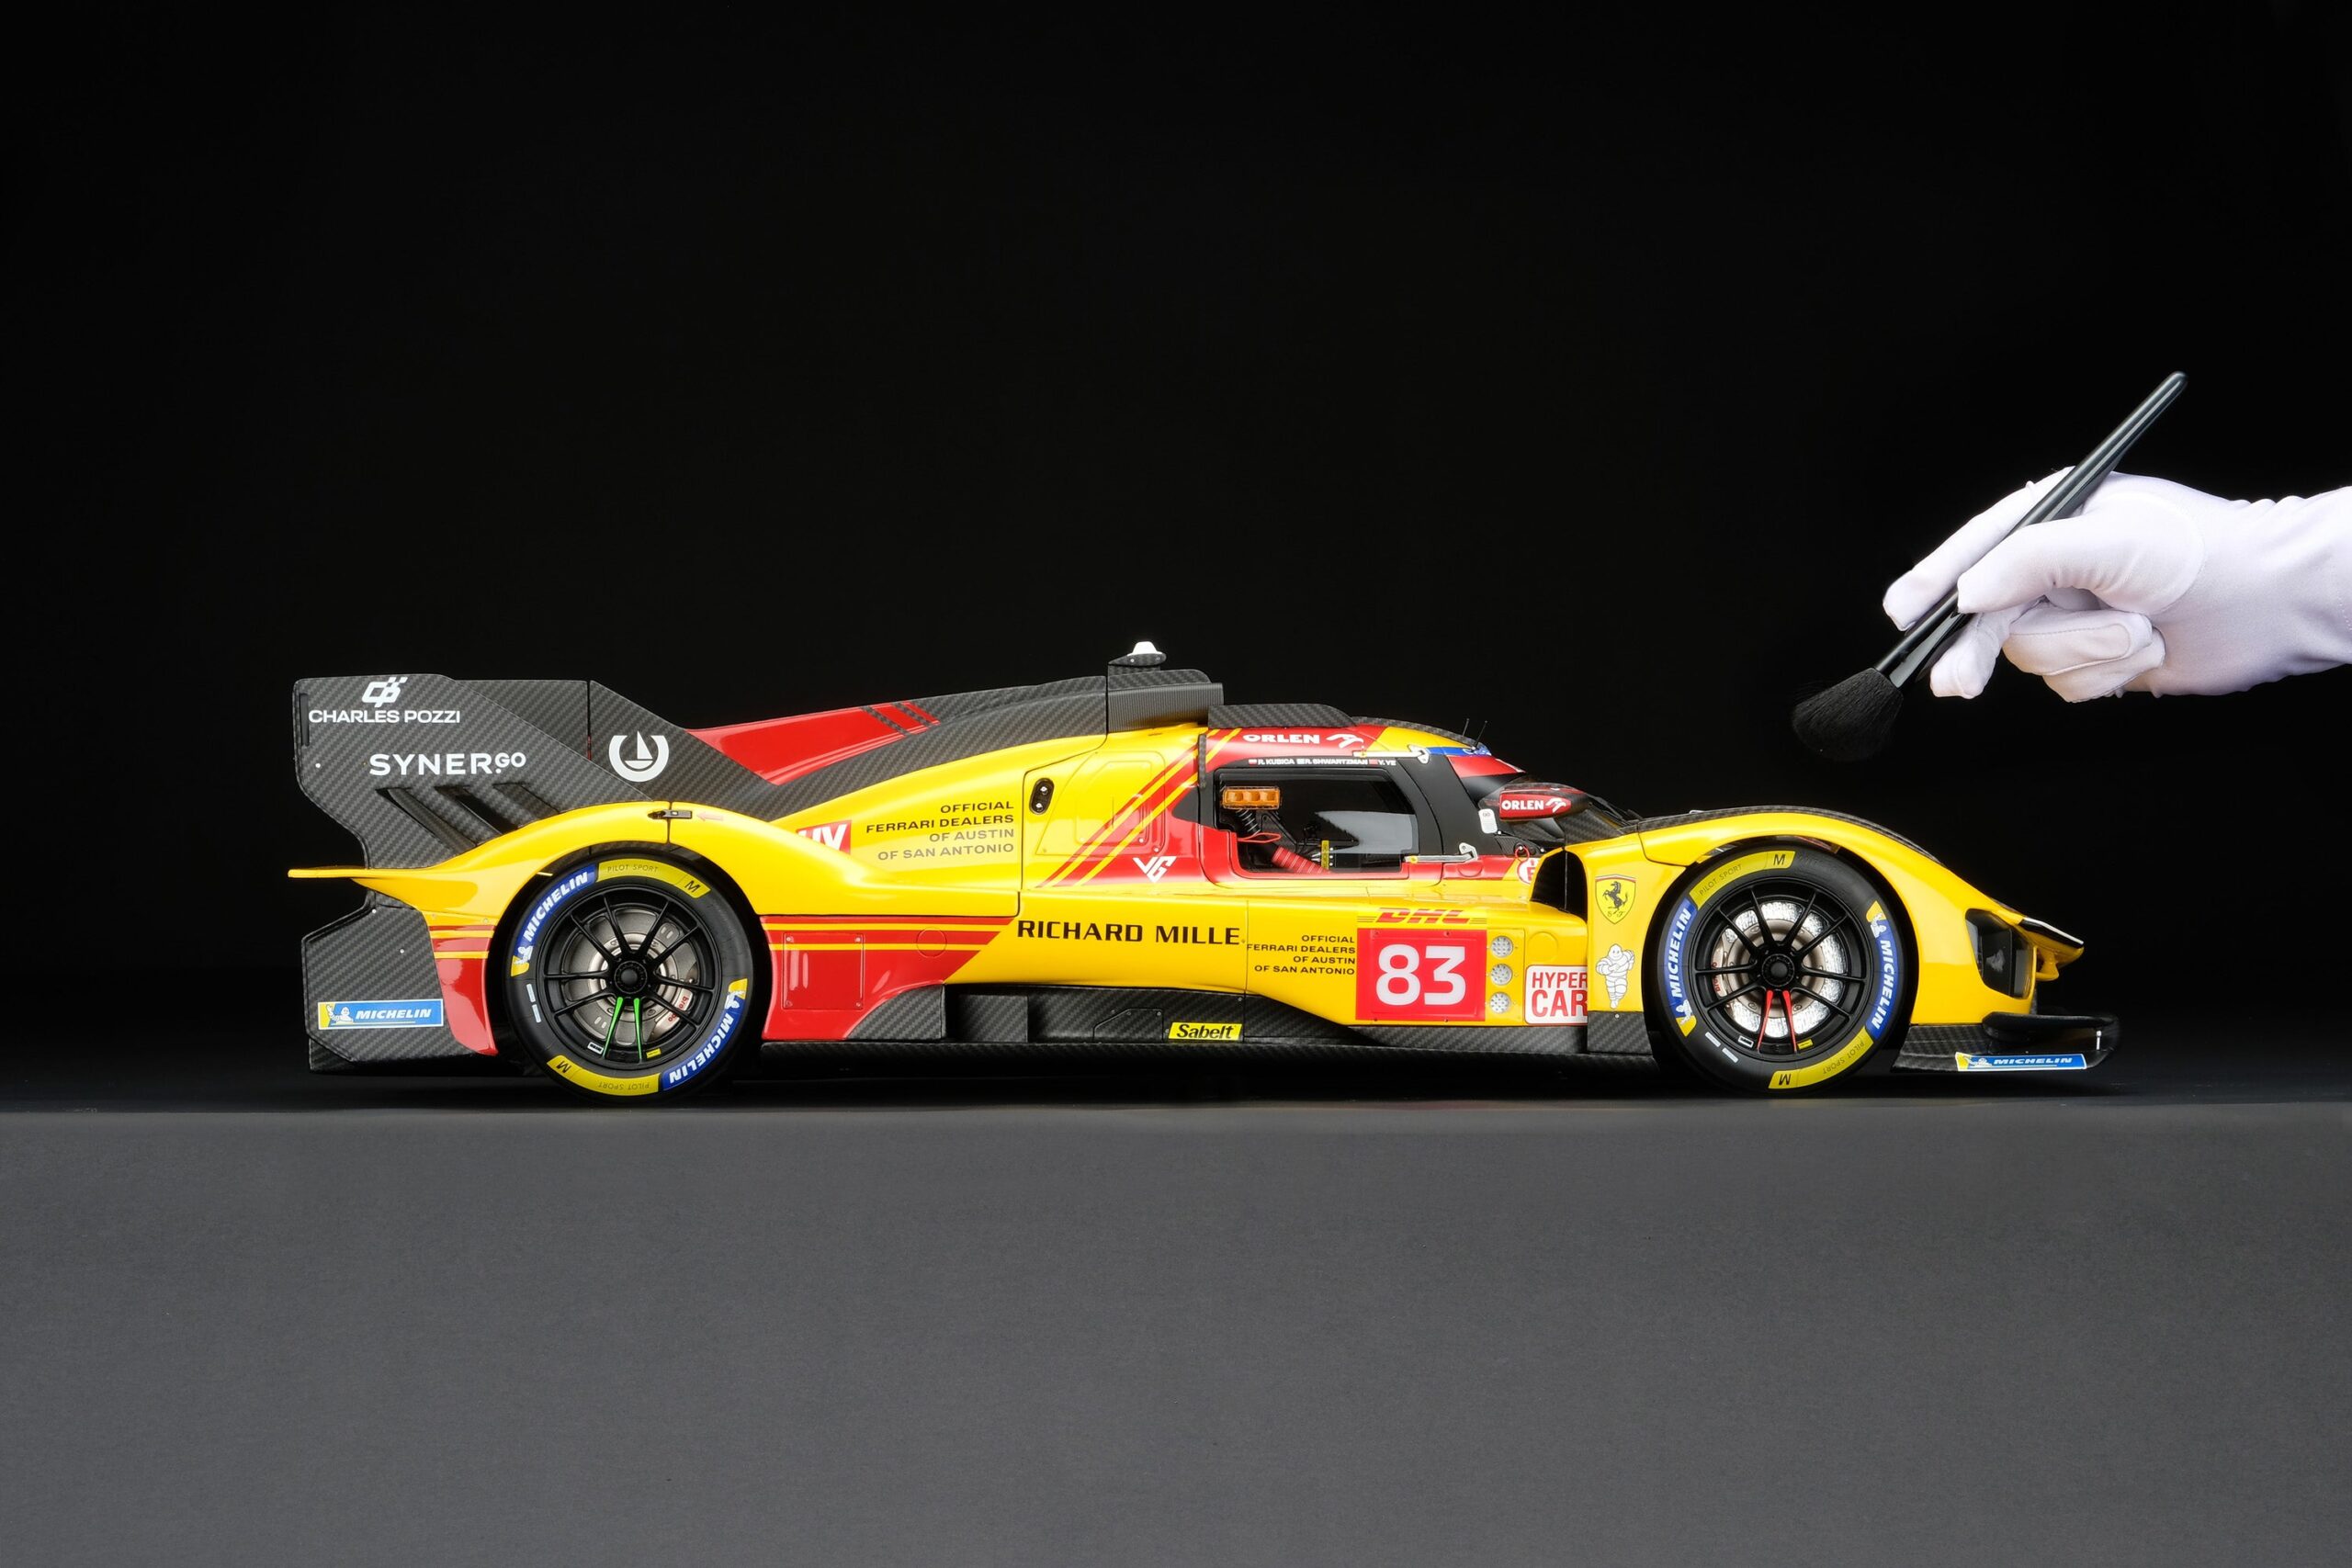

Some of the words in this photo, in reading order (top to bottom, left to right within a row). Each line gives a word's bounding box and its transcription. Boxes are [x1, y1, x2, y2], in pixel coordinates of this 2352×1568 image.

[309, 710, 400, 723] CHARLES
[404, 710, 460, 723] POZZI
[1243, 734, 1320, 744] ORLEN
[941, 801, 1014, 814] OFFICIAL
[1501, 800, 1544, 810] ORLEN
[866, 819, 934, 833] FERRARI
[940, 815, 1014, 828] DEALERS
[930, 833, 950, 843] OF
[954, 829, 1014, 840] AUSTIN
[877, 851, 899, 861] OF
[903, 848, 935, 859] SAN
[940, 843, 1014, 856] ANTONIO
[1773, 853, 1786, 866] M
[607, 863, 628, 873] PILOT
[633, 863, 659, 873] SPORT
[684, 880, 701, 893] M
[1700, 879, 1718, 897] PILOT
[1719, 864, 1742, 880] SPORT
[523, 871, 589, 942] MICHELIN
[1376, 908, 1470, 924] DHL
[1017, 920, 1143, 942] RICHARD
[1156, 925, 1240, 945] MILLE
[1302, 935, 1354, 943] OFFICIAL
[1247, 943, 1297, 952] FERRARI
[1301, 945, 1355, 953] DEALERS
[1668, 908, 1692, 998] MICHELIN
[1312, 956, 1355, 964] AUSTIN
[1300, 966, 1355, 975] ANTONIO
[1375, 944, 1466, 1006] 83
[1532, 972, 1588, 988] HYPER
[1871, 940, 1894, 1030] MICHELIN
[1532, 989, 1588, 1017] CAR
[355, 1009, 432, 1020] MICHELIN
[1176, 1023, 1234, 1039] Sabelt
[669, 1011, 735, 1085] MICHELIN
[1848, 1041, 1865, 1058] PILOT
[556, 1060, 571, 1074] M
[1823, 1058, 1846, 1075] SPORT
[1994, 1057, 2073, 1066] MICHELIN
[597, 1081, 625, 1090] SPORT
[628, 1082, 650, 1091] PILOT
[1779, 1073, 1792, 1086] M
